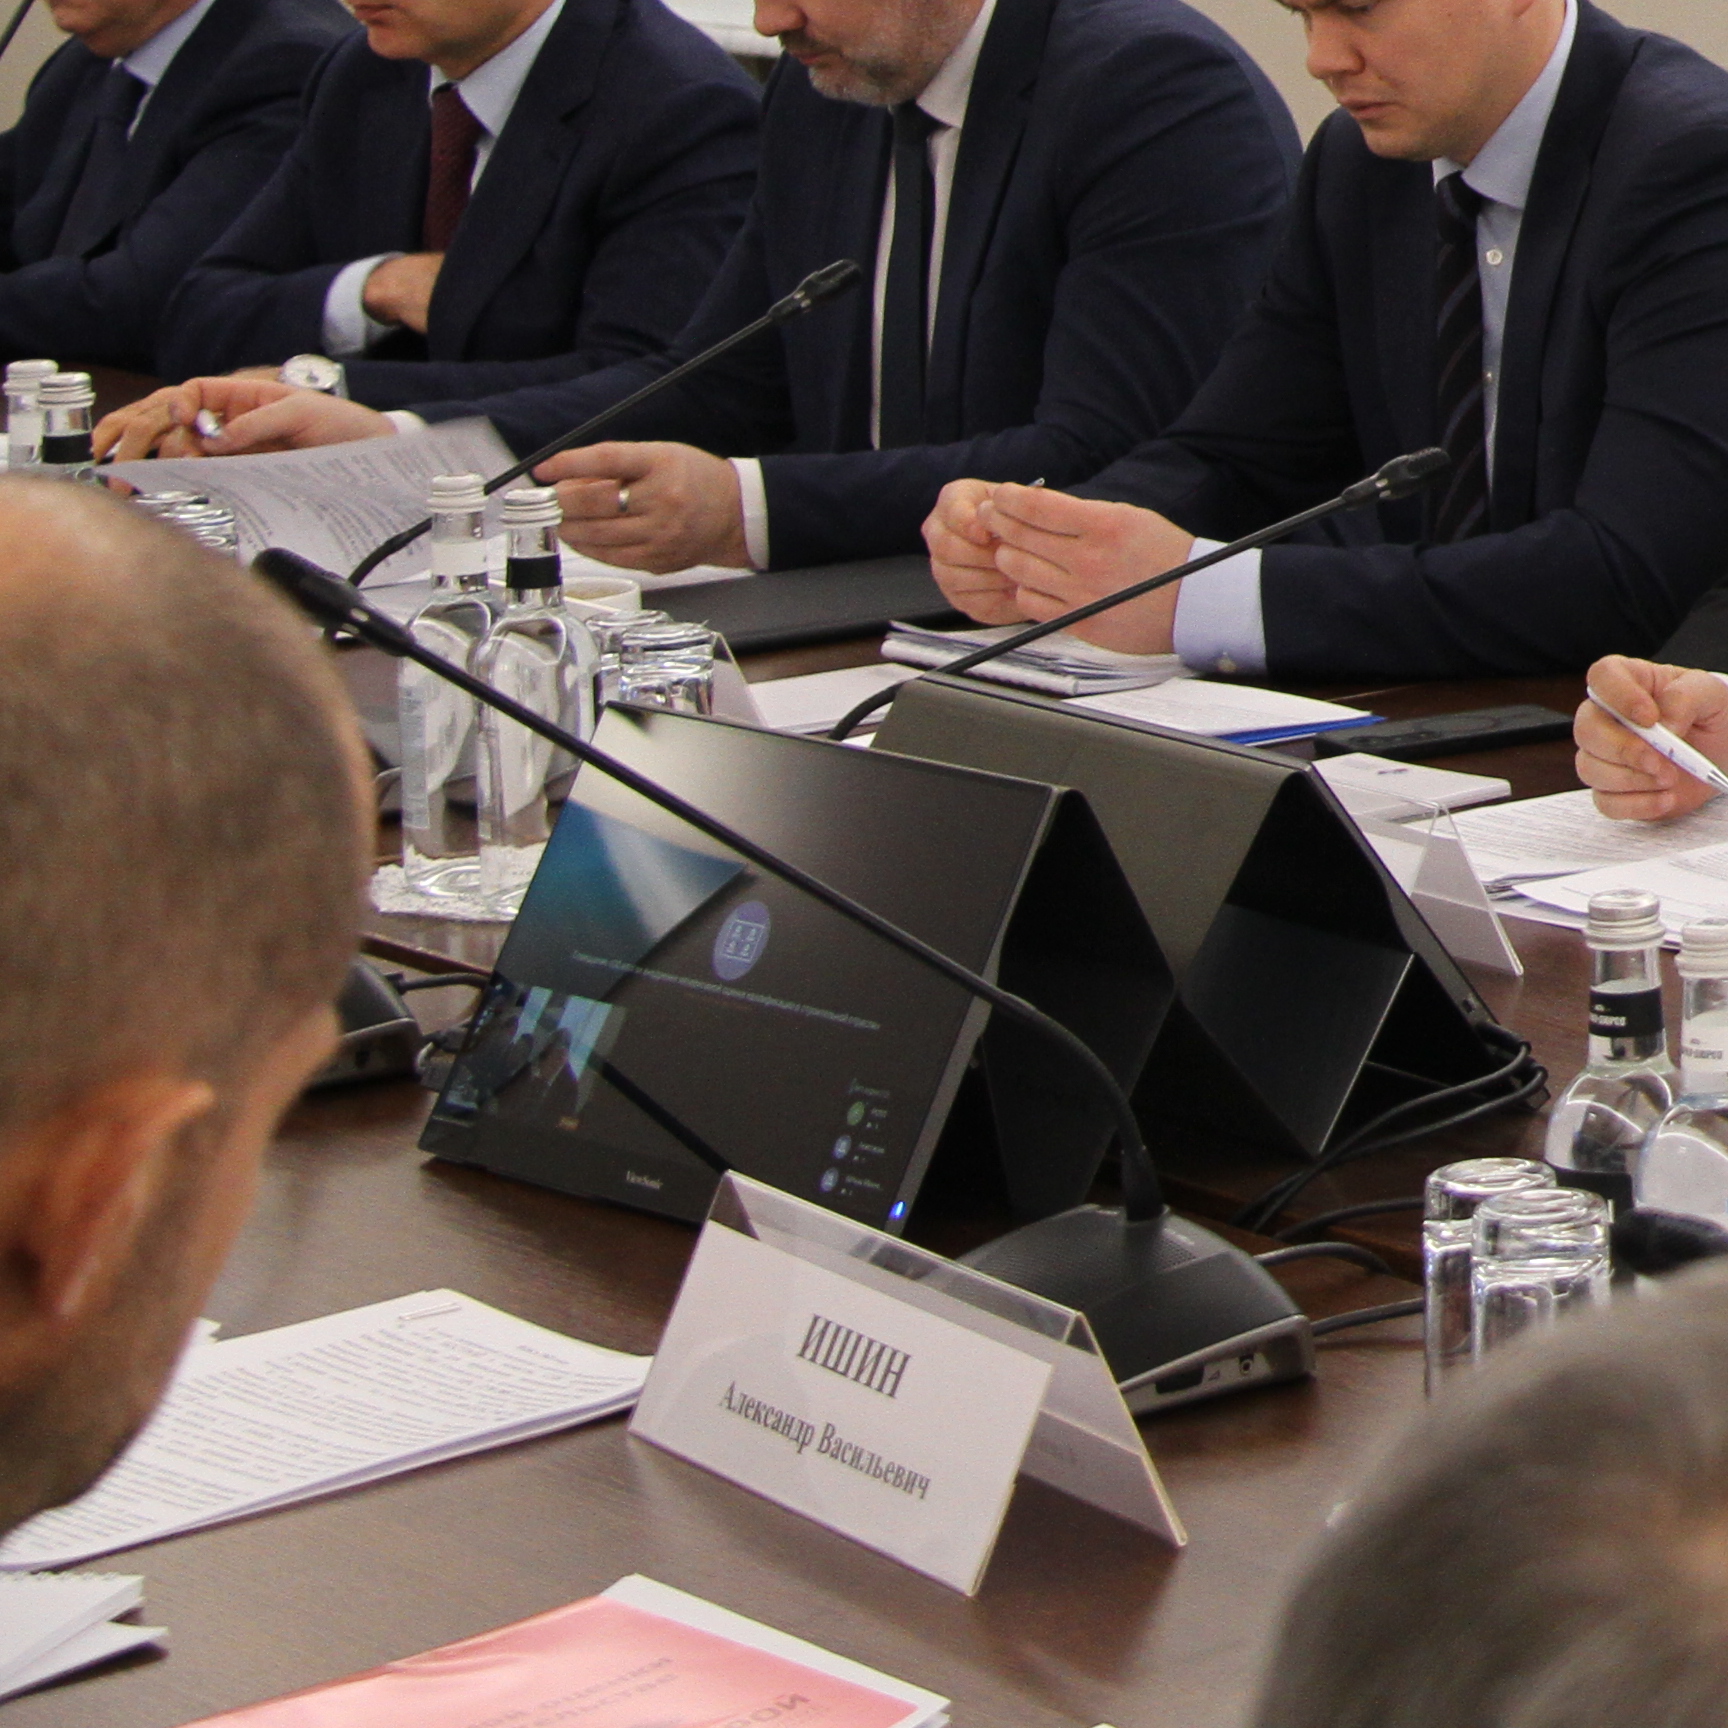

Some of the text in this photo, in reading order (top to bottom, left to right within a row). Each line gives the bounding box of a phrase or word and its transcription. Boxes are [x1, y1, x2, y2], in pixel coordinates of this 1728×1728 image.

[797, 1313, 911, 1399] ИШИН
[719, 1381, 931, 1500] Александр Васильевич
